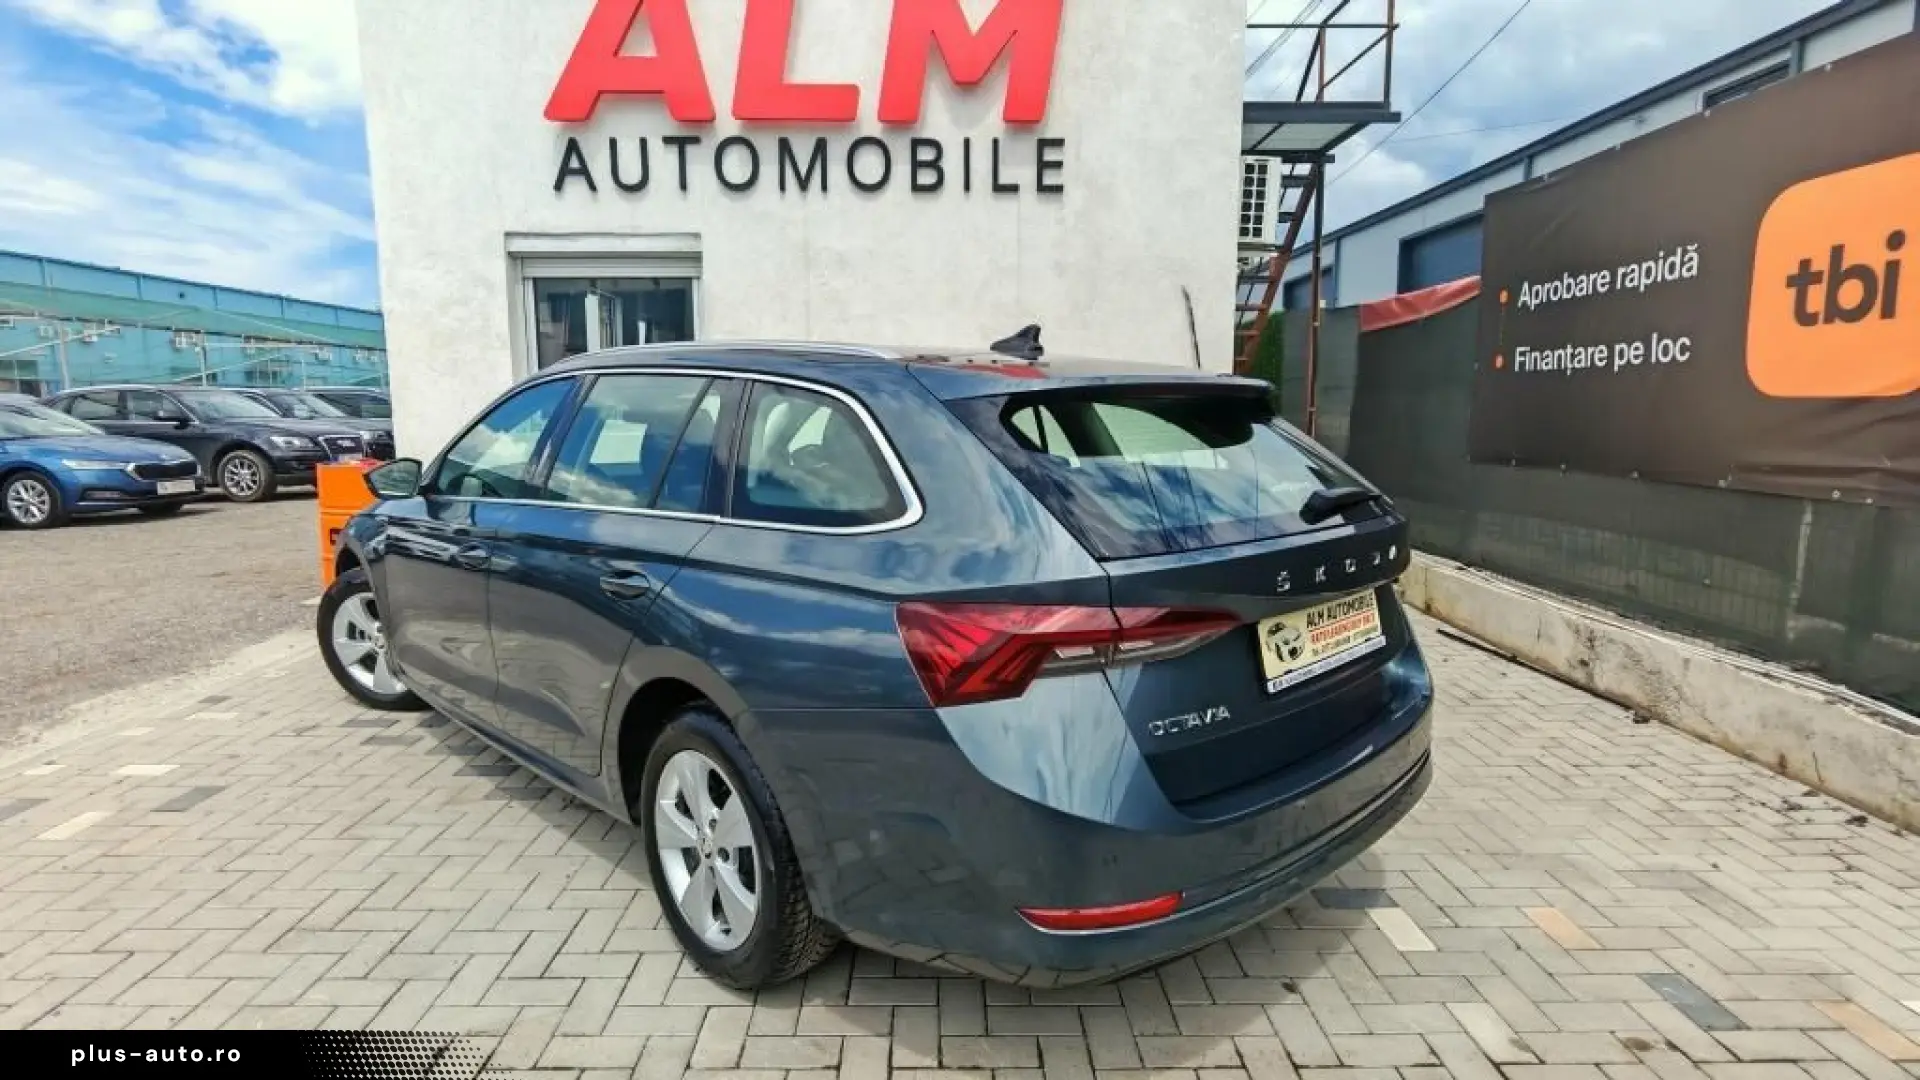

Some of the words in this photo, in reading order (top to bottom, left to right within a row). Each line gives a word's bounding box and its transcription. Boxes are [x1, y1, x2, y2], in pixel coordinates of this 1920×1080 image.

[543, 0, 1063, 123] ALM
[553, 136, 1066, 194] AUTOMOBILE
[1517, 268, 1610, 310] Aprobare
[1616, 243, 1699, 294] rapidă
[1785, 229, 1907, 328] tbi
[1514, 341, 1608, 375] Finanțare
[1613, 338, 1644, 373] pe
[1651, 332, 1691, 364] loc
